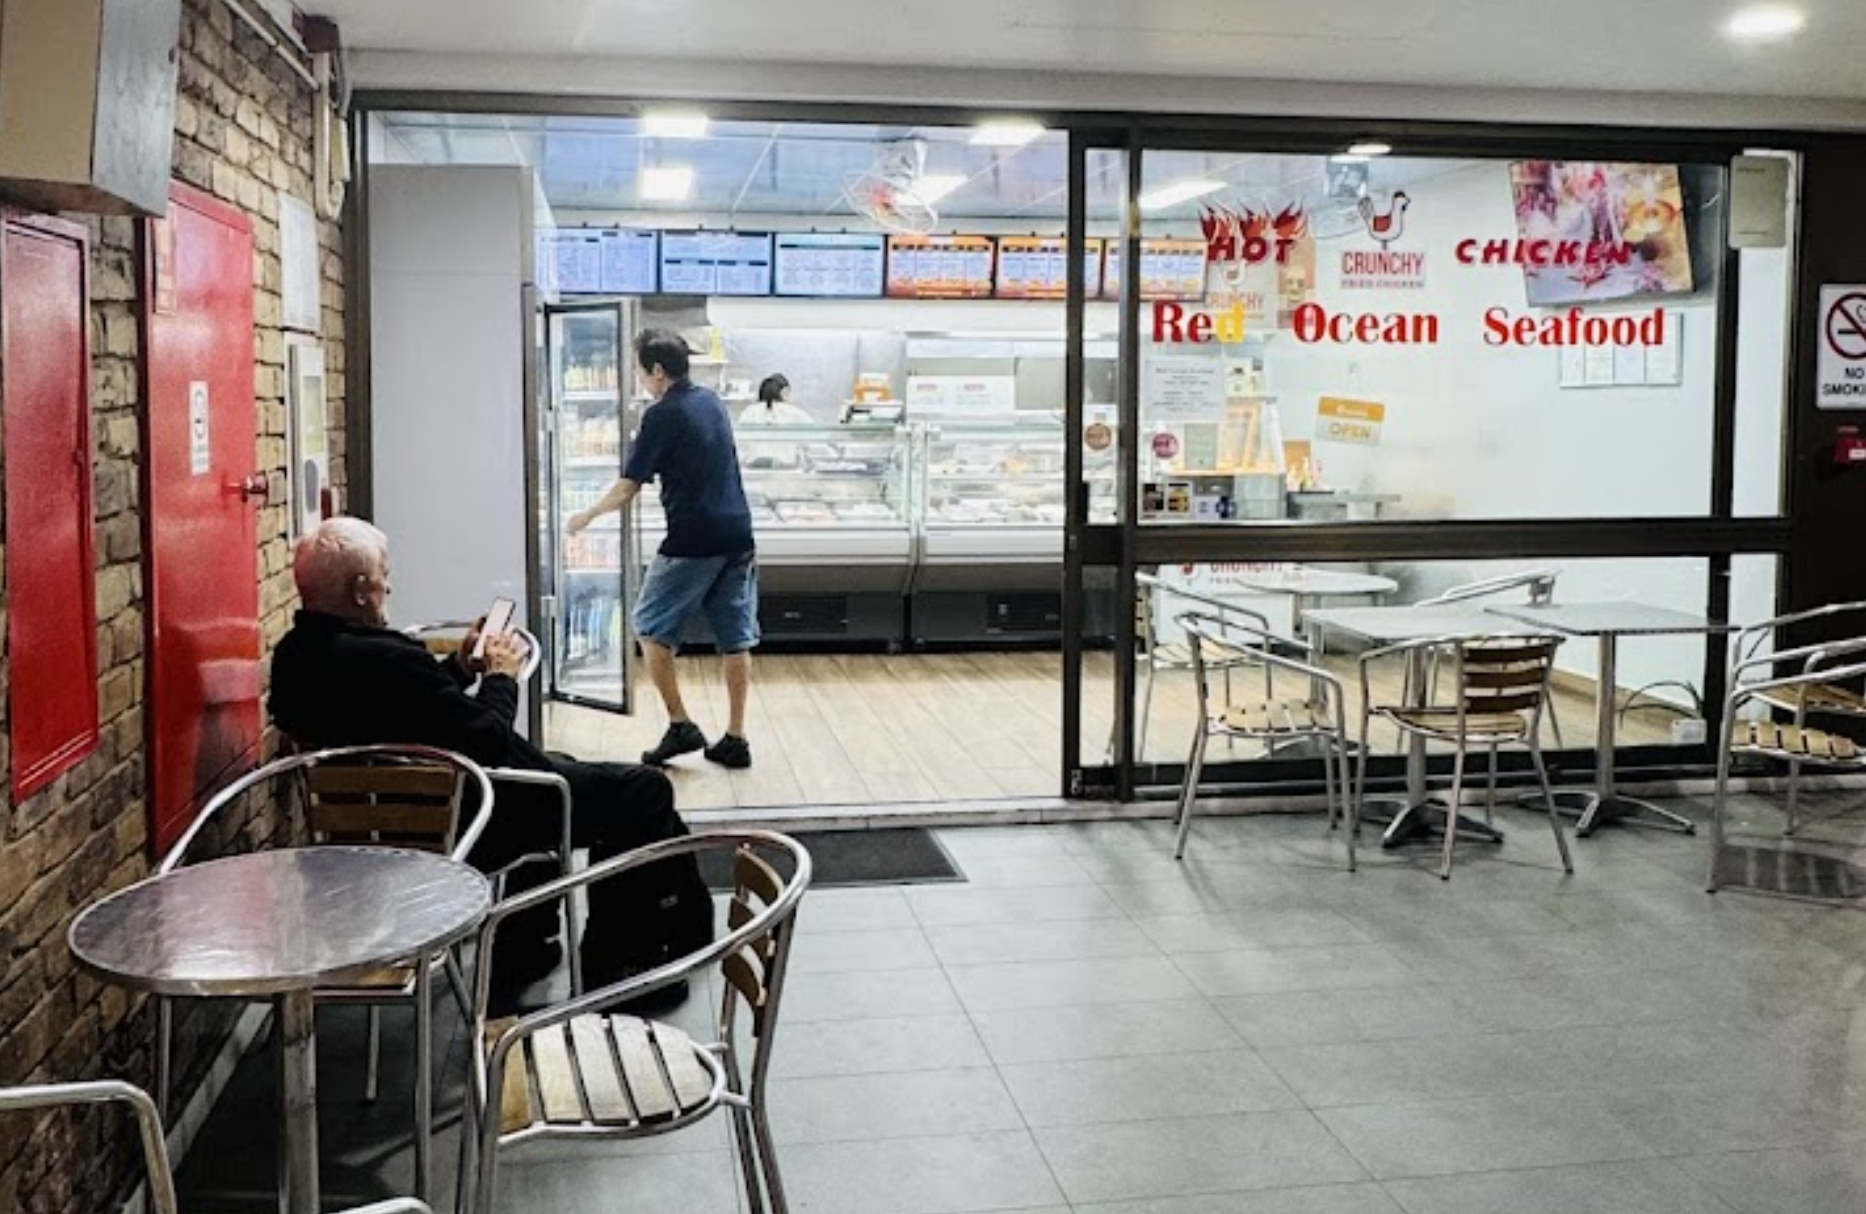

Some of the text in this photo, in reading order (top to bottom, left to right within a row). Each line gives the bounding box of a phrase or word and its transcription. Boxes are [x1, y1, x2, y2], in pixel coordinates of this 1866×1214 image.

[1207, 236, 1638, 265] HOT CHICKEN
[1343, 252, 1424, 275] CRUNCHY
[1152, 299, 1665, 346] Red Ocean Seafood
[1844, 367, 1864, 379] NO
[1329, 422, 1371, 439] OPEN
